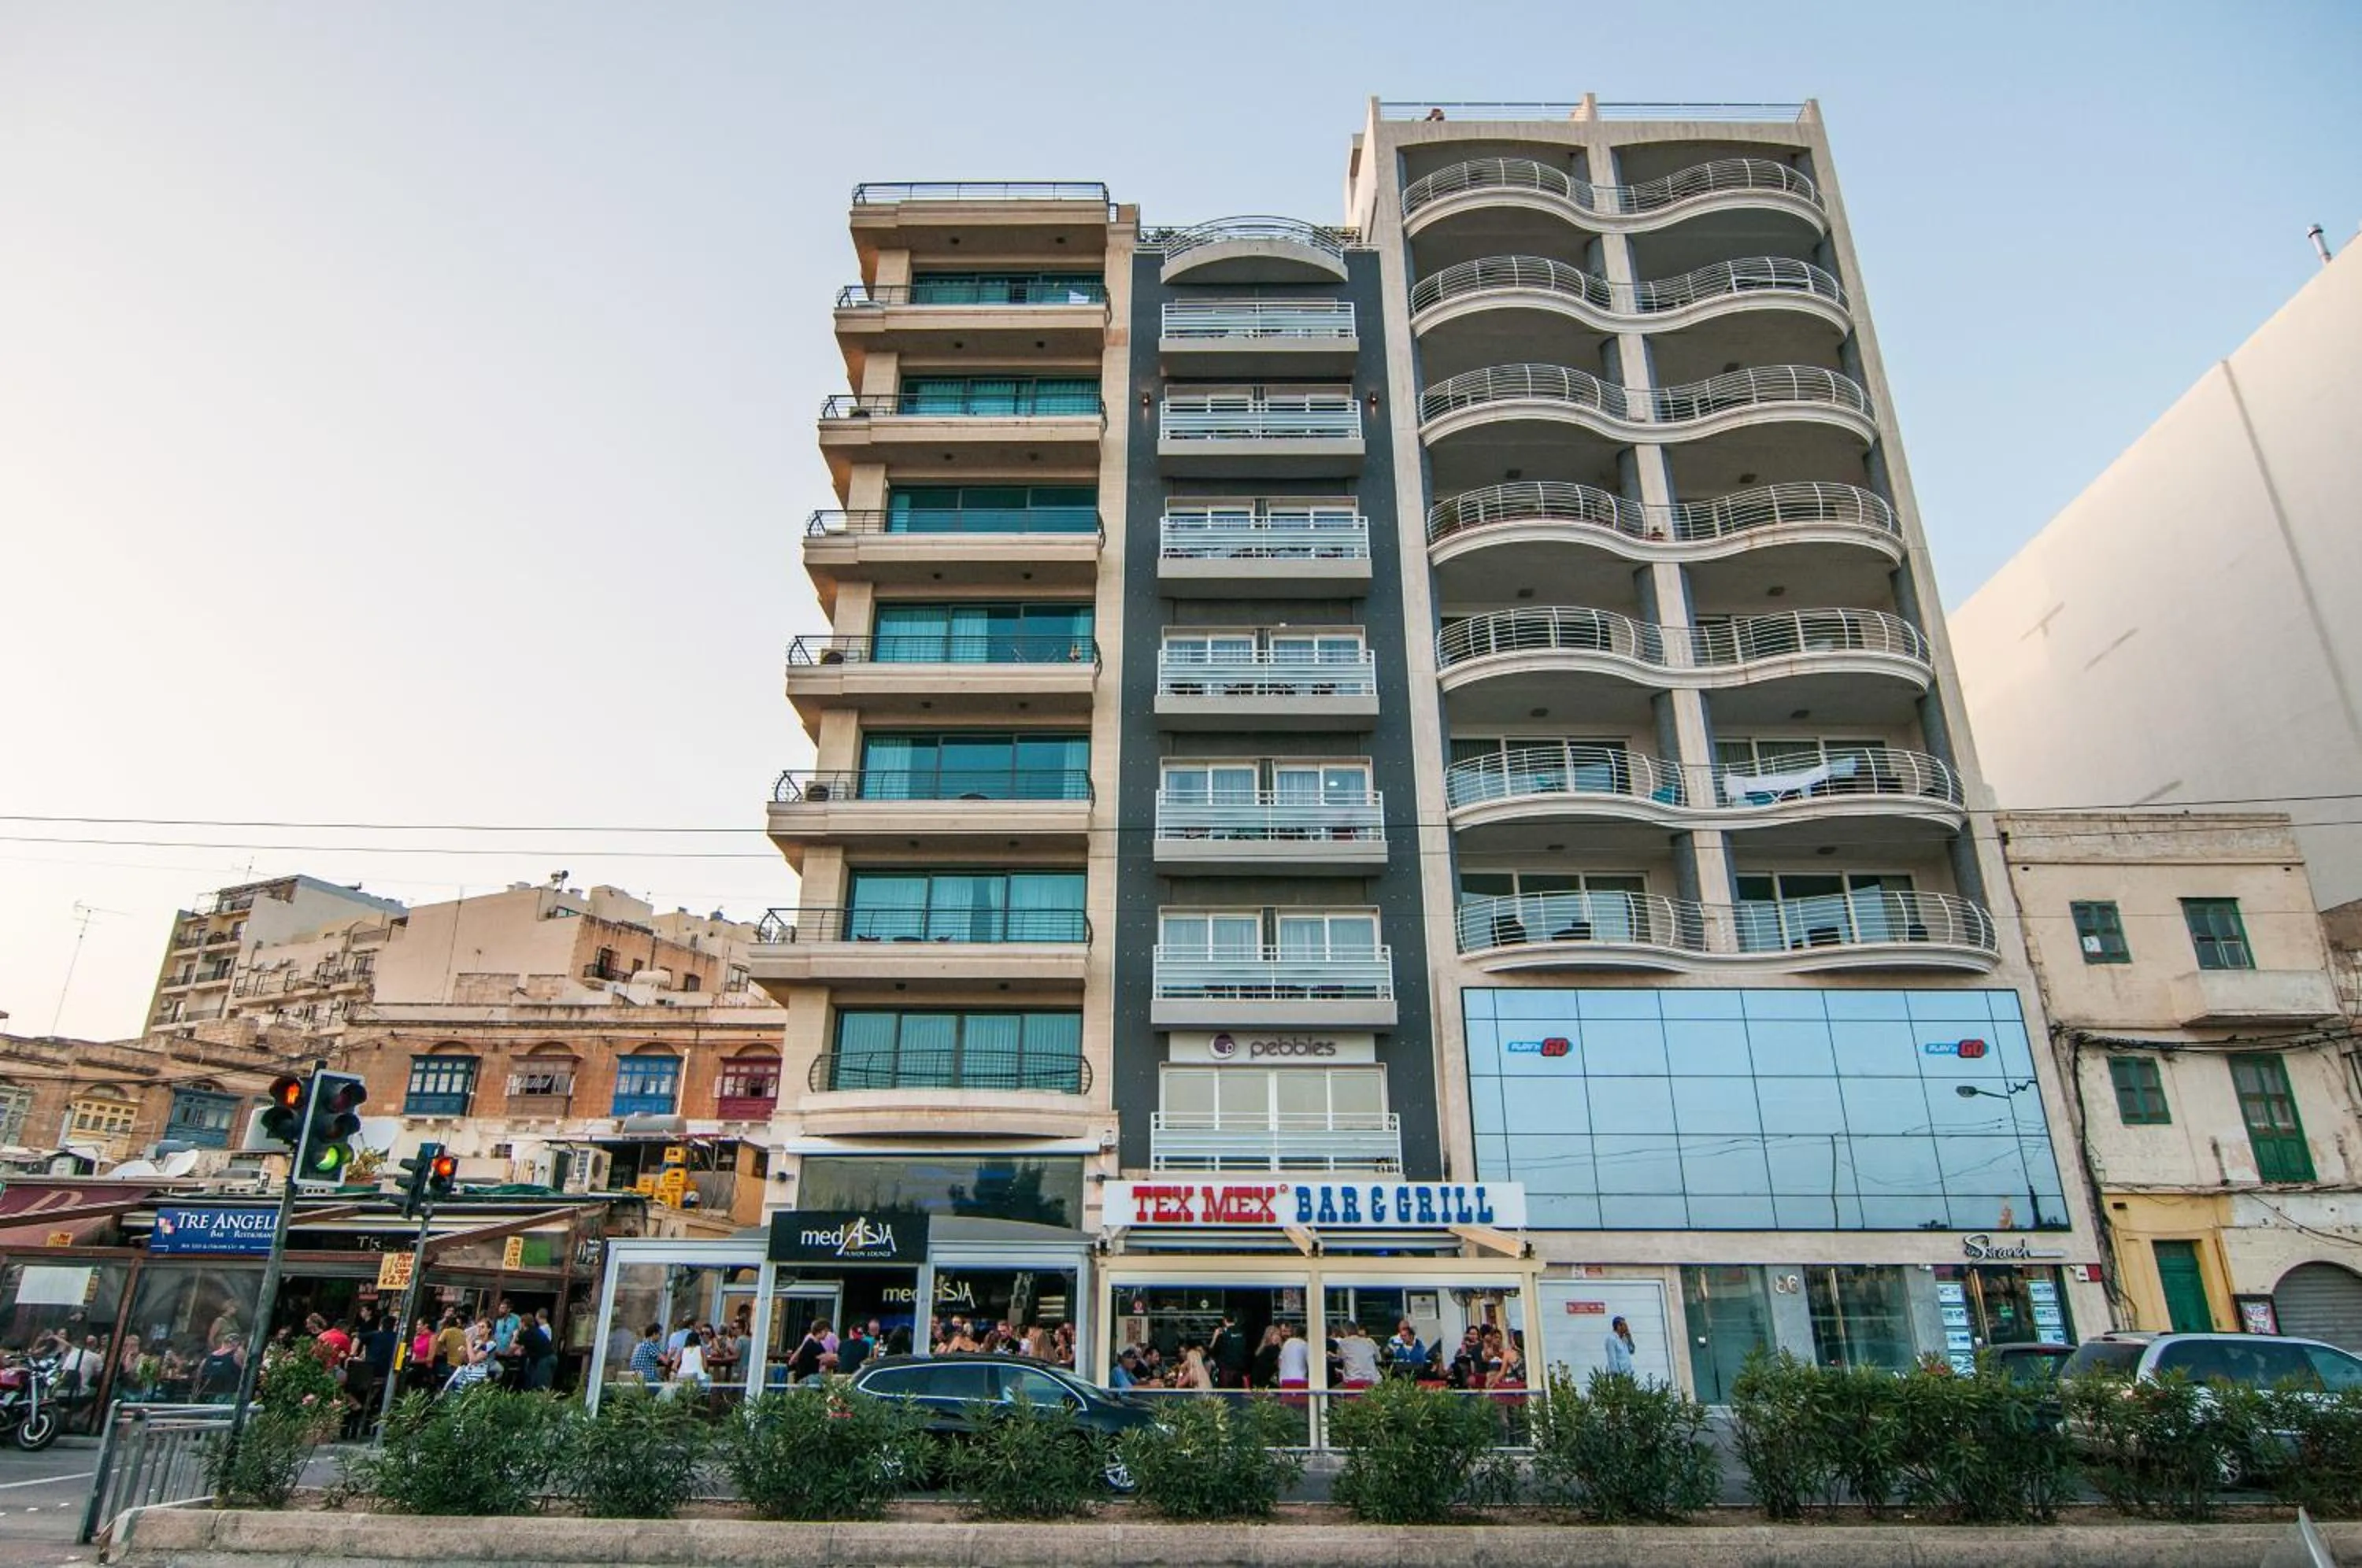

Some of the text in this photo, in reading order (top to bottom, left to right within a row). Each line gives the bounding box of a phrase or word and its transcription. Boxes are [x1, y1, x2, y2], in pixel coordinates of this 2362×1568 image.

[1250, 1036, 1337, 1060] pebbles
[1543, 1039, 1568, 1056] GO
[1960, 1041, 1984, 1057] GO
[1132, 1185, 1194, 1222] TEX
[1296, 1186, 1361, 1223] BAR
[1371, 1185, 1386, 1223] &
[1396, 1186, 1494, 1223] GRILL
[177, 1211, 210, 1229] TRE
